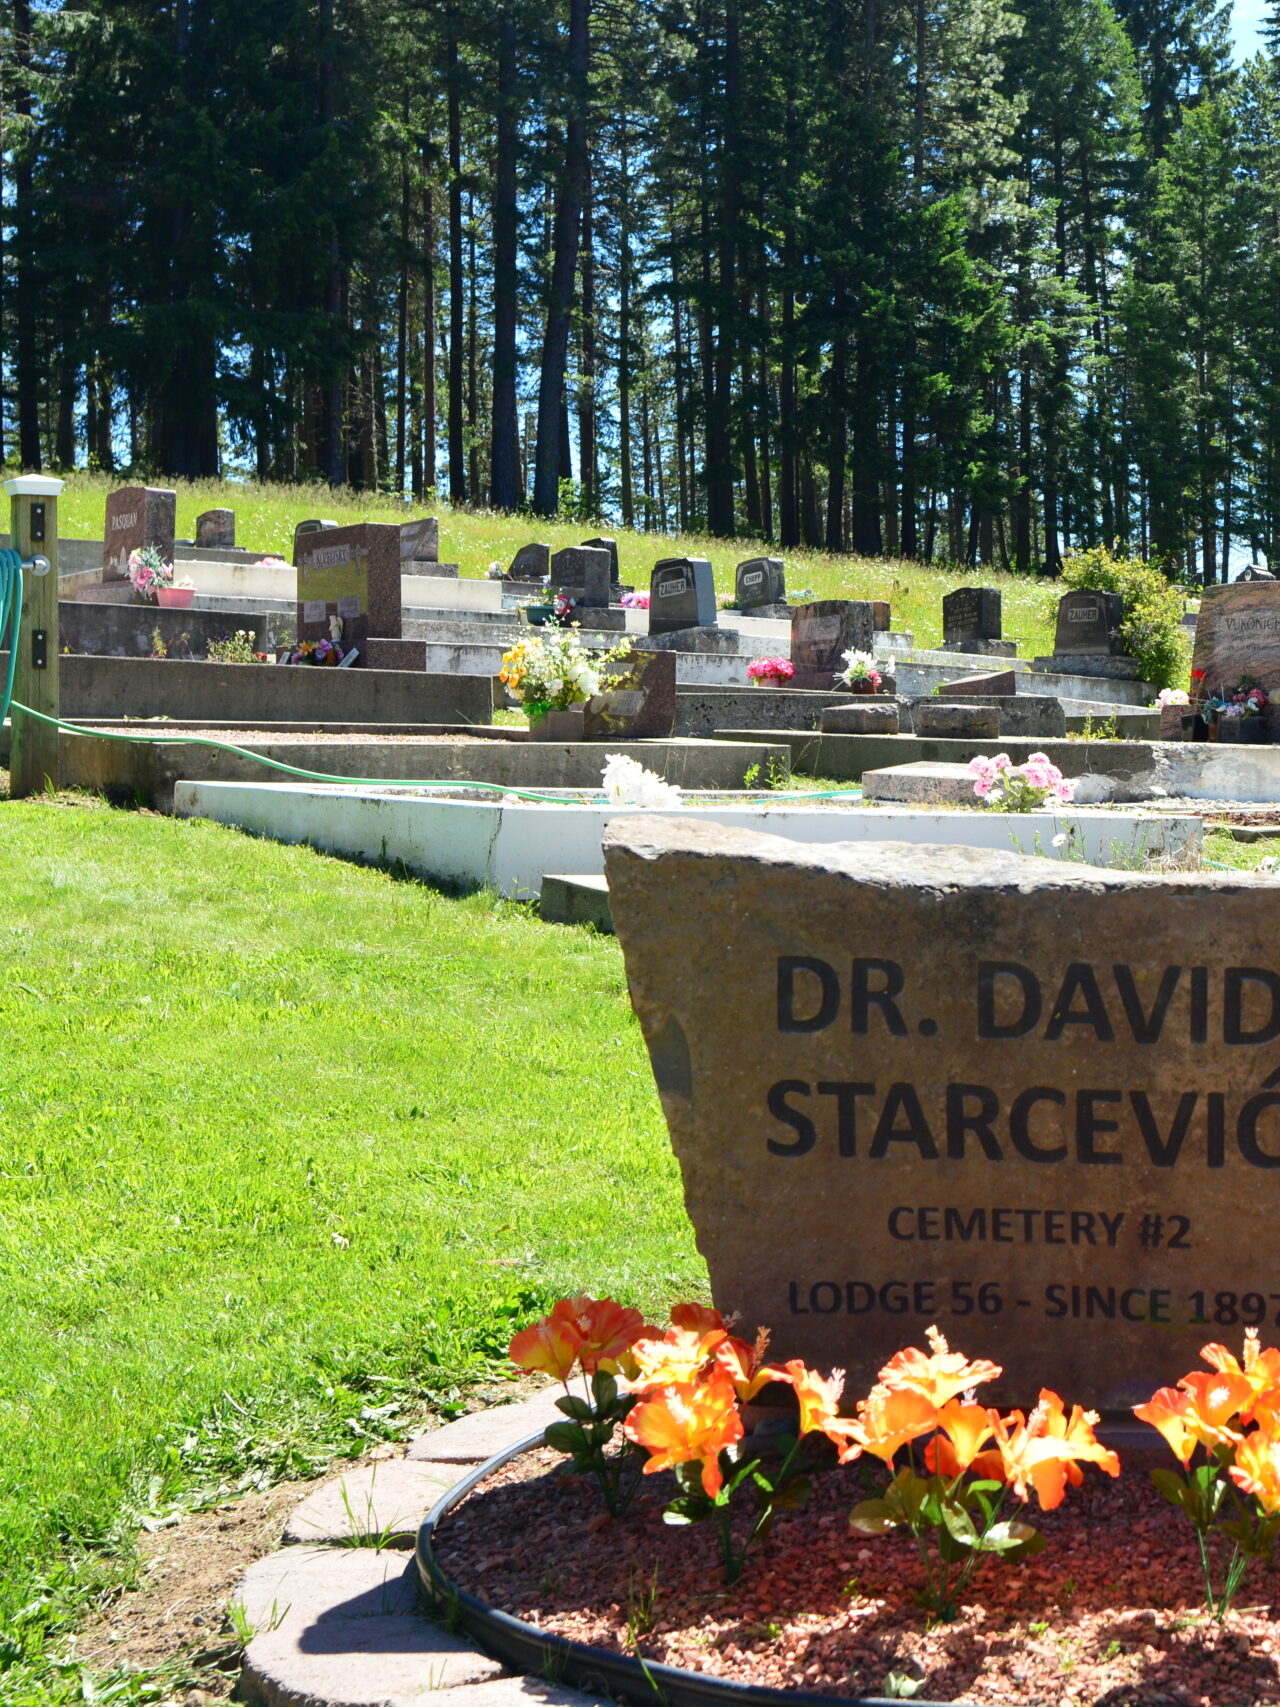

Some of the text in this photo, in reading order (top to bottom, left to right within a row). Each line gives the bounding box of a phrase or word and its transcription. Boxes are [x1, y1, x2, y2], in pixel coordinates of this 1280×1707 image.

[111, 512, 138, 531] PASQUAN
[776, 955, 938, 1037] DR.
[887, 1206, 1192, 1250] CEMETERY #2
[788, 1280, 935, 1316] LODGE
[951, 1281, 1002, 1316] 56
[1045, 1284, 1172, 1324] SINCE
